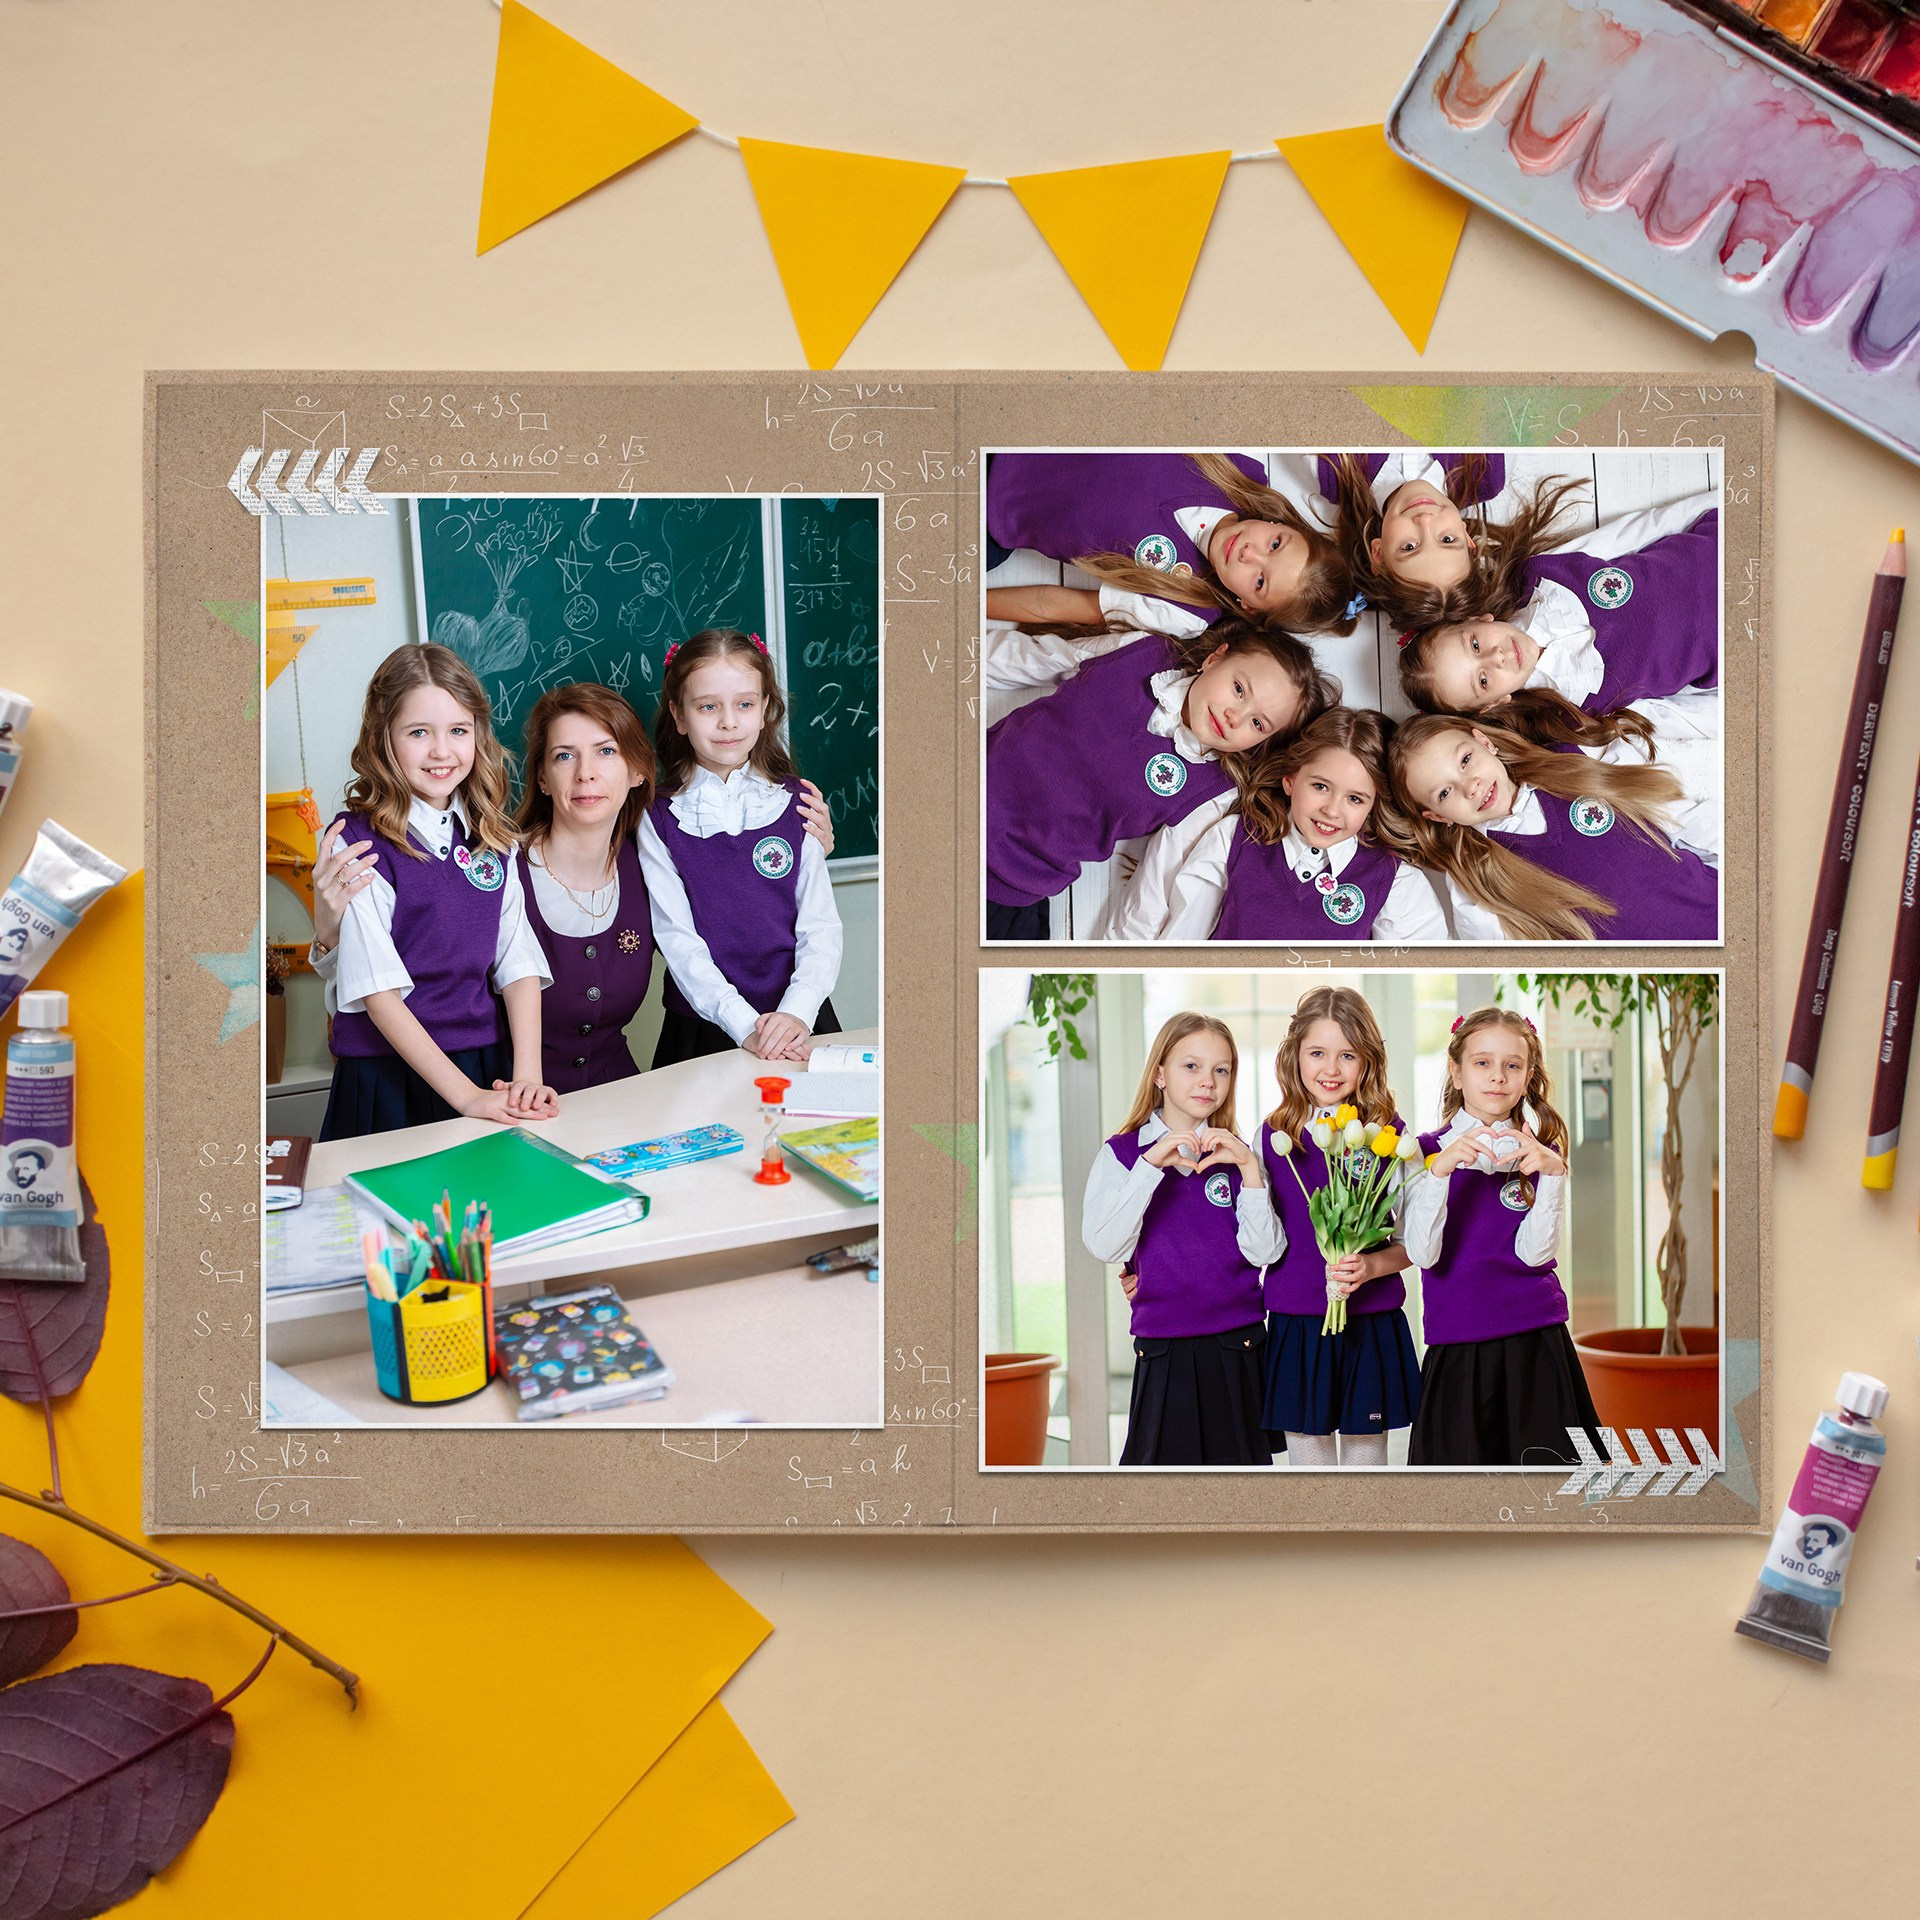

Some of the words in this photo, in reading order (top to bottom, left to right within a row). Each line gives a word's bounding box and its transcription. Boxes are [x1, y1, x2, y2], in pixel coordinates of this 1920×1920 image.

[292, 633, 306, 643] 50
[1856, 702, 1878, 771] DERWENT
[1839, 783, 1863, 862] coloursoft
[1, 898, 30, 927] Gogh
[32, 916, 55, 941] van
[1823, 929, 1838, 951] Deep
[1889, 979, 1903, 1008] Lemon
[1885, 1009, 1899, 1037] Yellow
[40, 1066, 55, 1075] 593
[27, 1191, 64, 1208] Gogh
[1780, 1554, 1804, 1574] van
[1807, 1562, 1841, 1586] Gogh
